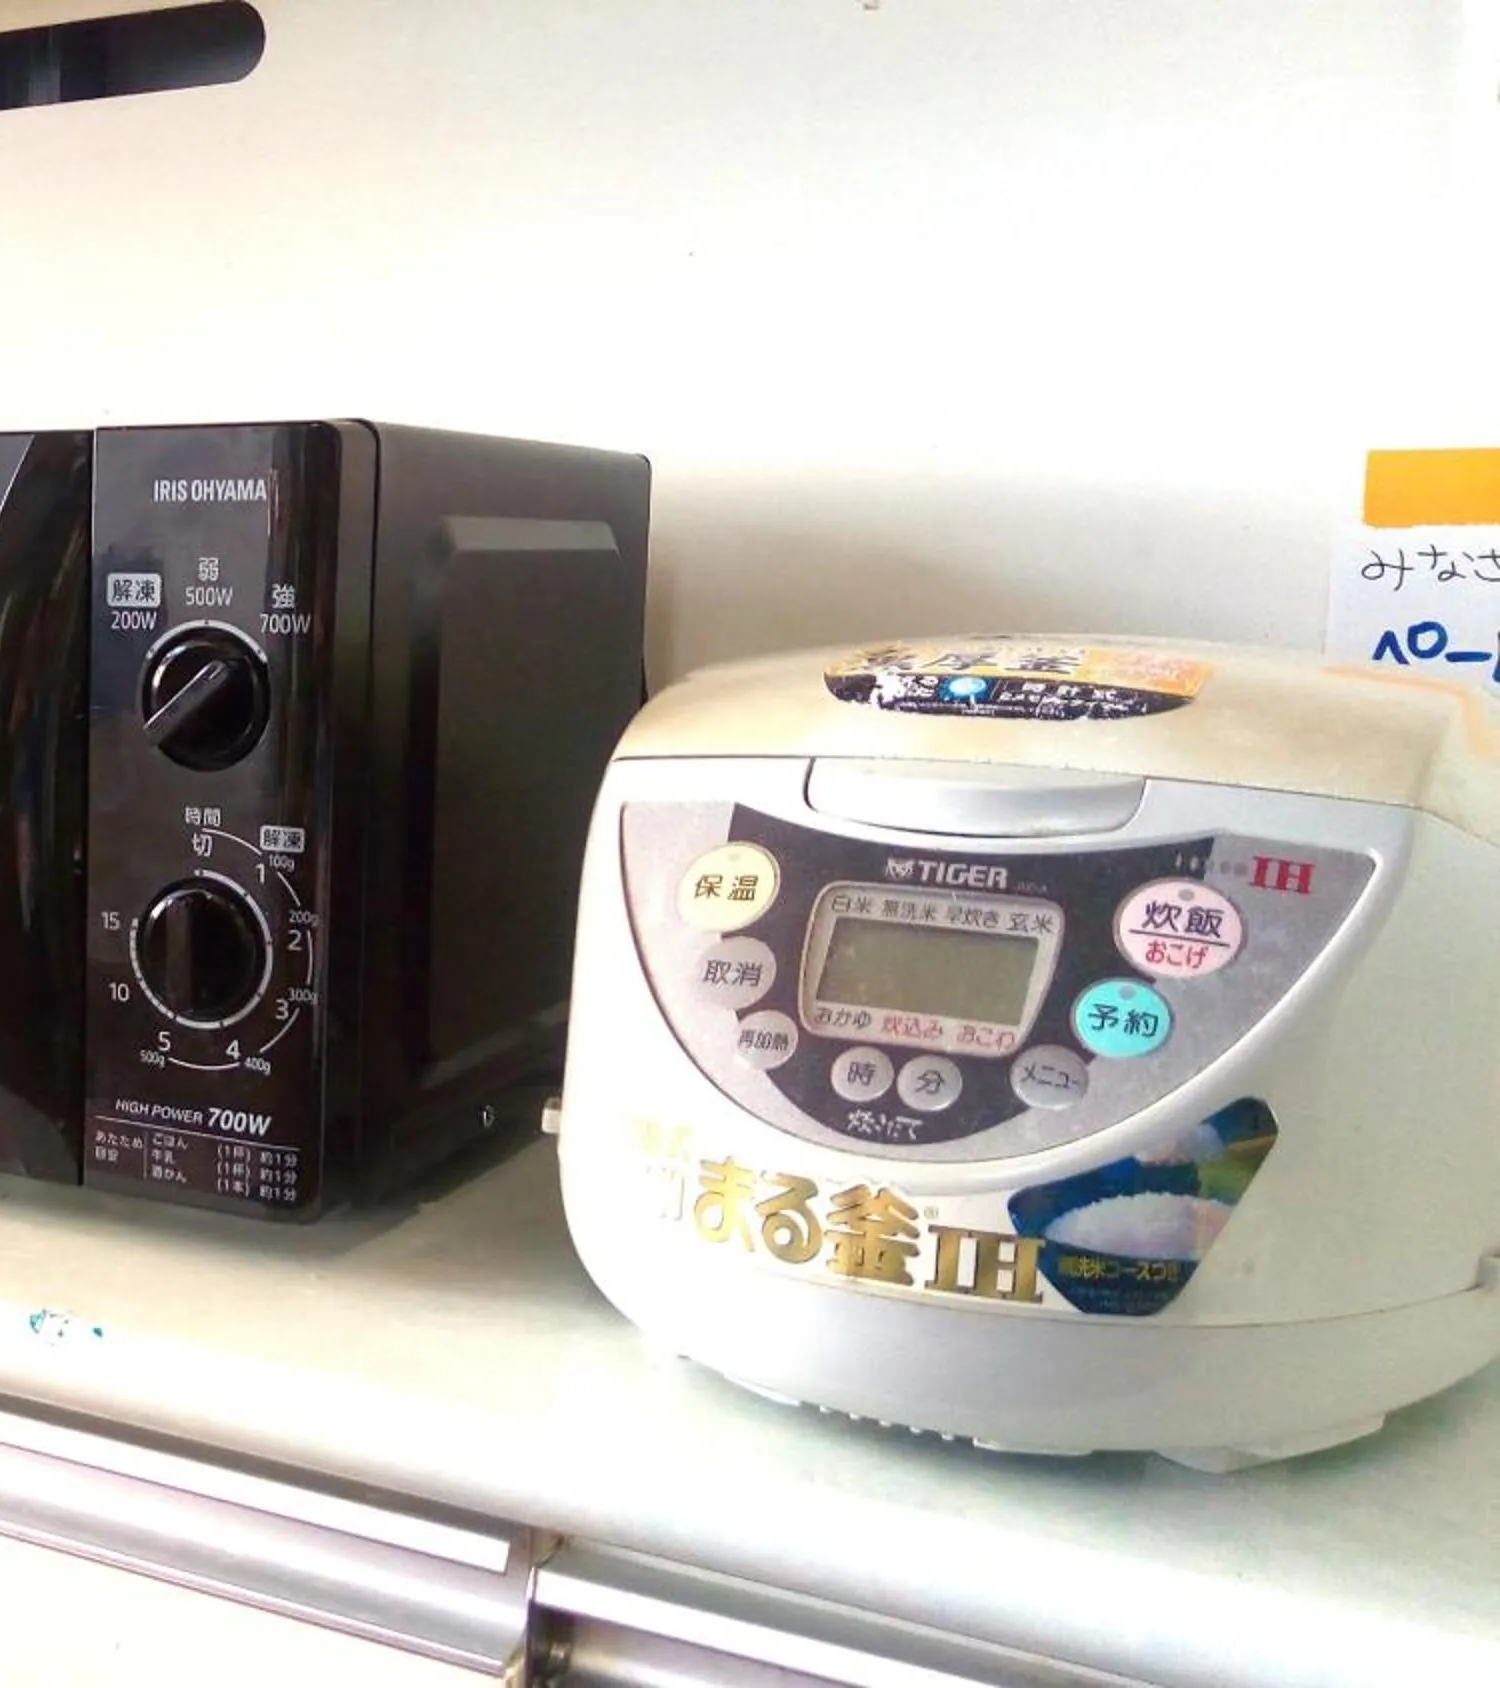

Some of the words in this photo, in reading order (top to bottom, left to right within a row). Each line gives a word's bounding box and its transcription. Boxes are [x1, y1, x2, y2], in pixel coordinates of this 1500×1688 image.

[154, 479, 188, 502] IRIS
[191, 479, 267, 501] OHYAMA
[199, 557, 219, 581] 弱
[111, 578, 157, 604] 解凍
[185, 587, 233, 607] 500W
[271, 584, 296, 609] 強
[111, 611, 157, 630] 200W
[260, 613, 311, 635] 700W
[1372, 621, 1500, 683] ペー
[185, 806, 221, 827] 時間
[192, 833, 213, 857] 切
[255, 863, 266, 884] 1
[269, 854, 295, 871] 100g
[918, 861, 1008, 889] TIGER
[1251, 855, 1316, 895] IH
[694, 875, 759, 902] 保温
[101, 911, 121, 931] 15
[288, 910, 319, 927] 200g
[830, 895, 873, 914] 白米
[880, 899, 938, 921] 無洗米
[1006, 912, 1055, 934] 玄米
[1141, 900, 1226, 939] 炊飯
[288, 930, 302, 951] 2
[1143, 942, 1211, 969] おこげ
[703, 960, 764, 988] 取消
[108, 982, 130, 1003] 10
[287, 987, 320, 1006] 300g
[275, 1000, 289, 1020] 3
[1087, 1003, 1160, 1037] 予約
[814, 1006, 873, 1030] おかゆ
[879, 1015, 945, 1041] 炊込み
[956, 1024, 1016, 1049] おこわ
[158, 1031, 172, 1052] 5
[225, 1040, 241, 1060] 4
[738, 1028, 790, 1053] 再加熱
[139, 1049, 166, 1068] 500g
[243, 1056, 272, 1076] 400g
[846, 1061, 875, 1087] 時
[916, 1070, 946, 1095] 分
[1022, 1063, 1082, 1089] メニュー
[115, 1099, 149, 1114] HIGH
[151, 1104, 203, 1124] POWER
[207, 1107, 272, 1137] 700W
[95, 1130, 143, 1149] あたため
[152, 1132, 188, 1150] ごはん
[638, 1156, 920, 1287] まる釜
